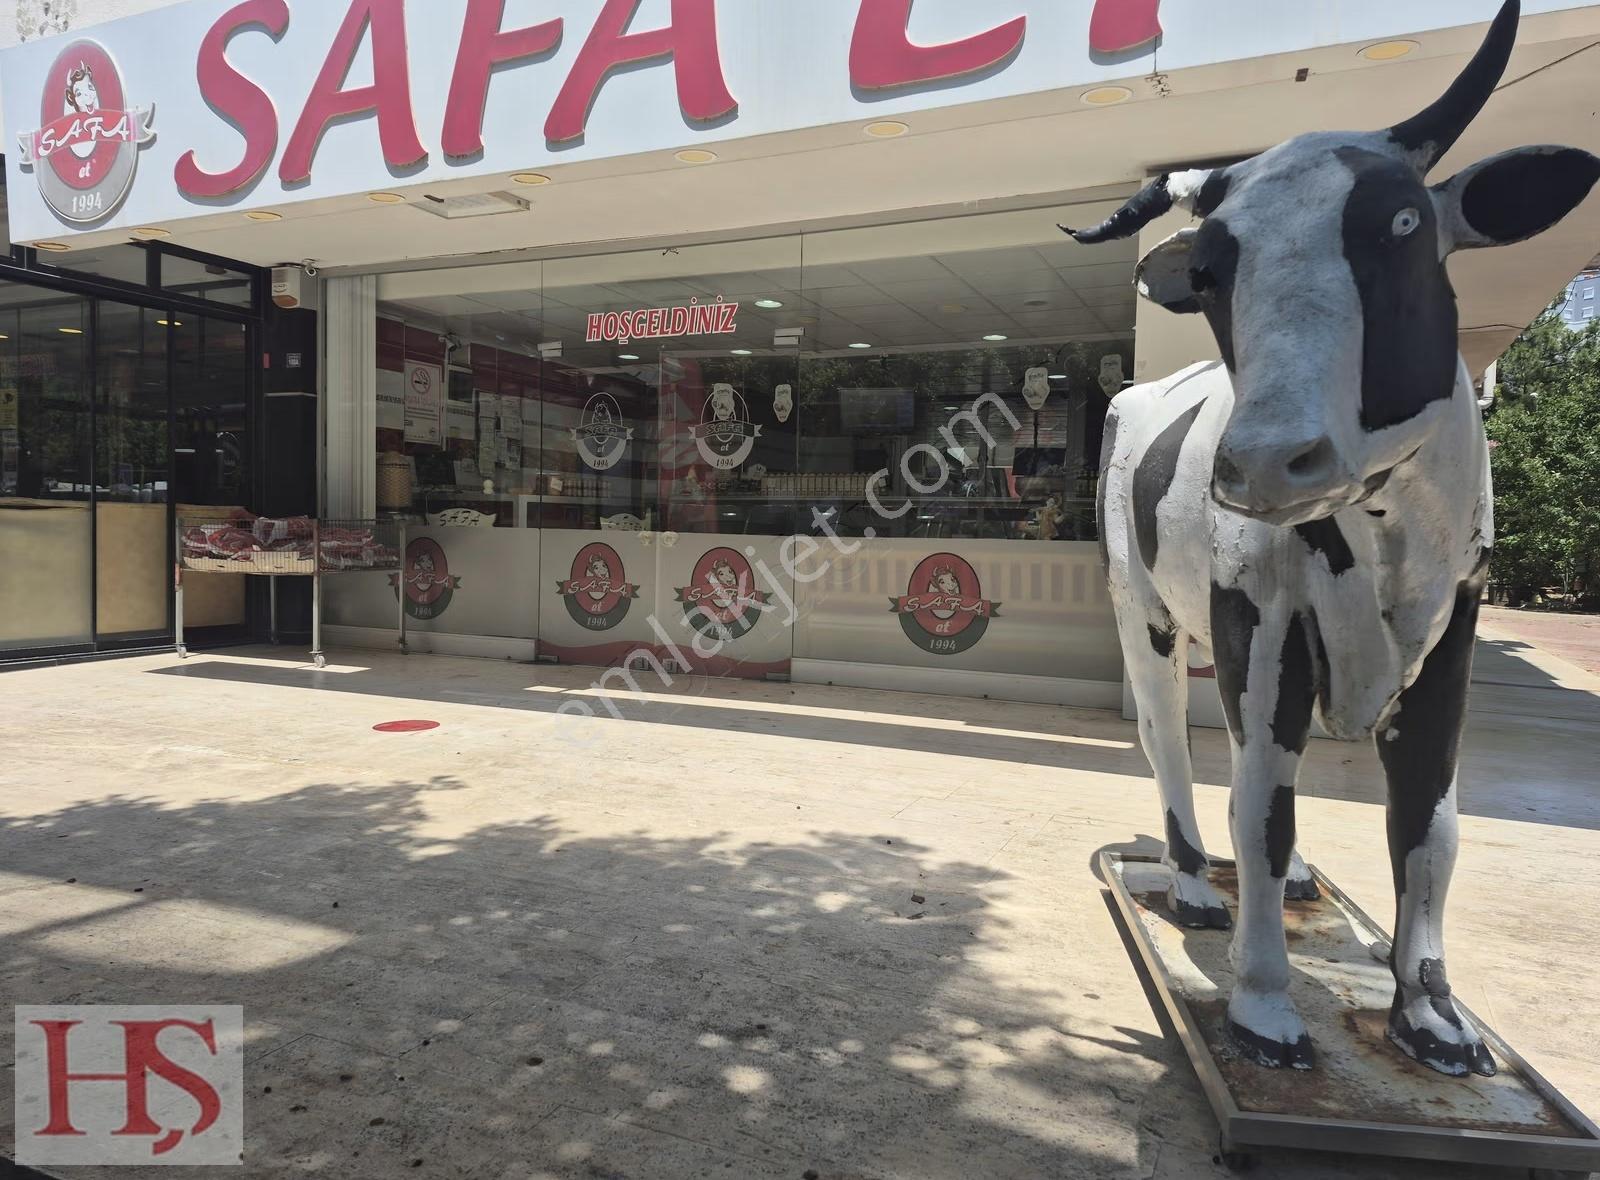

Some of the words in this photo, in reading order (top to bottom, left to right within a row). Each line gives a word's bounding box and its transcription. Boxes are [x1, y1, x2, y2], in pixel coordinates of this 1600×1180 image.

[174, 0, 739, 200] SAFA
[37, 115, 130, 157] SAFA
[78, 161, 91, 179] et
[71, 191, 102, 213] 1994
[585, 295, 739, 345] HOŞGELDİNİZ
[716, 458, 735, 468] 1994
[403, 572, 449, 588] AFA
[567, 580, 628, 597] SAFA
[903, 594, 984, 616] SAFA
[587, 616, 607, 627] 1994
[935, 620, 951, 633] et
[929, 638, 957, 651] 1994
